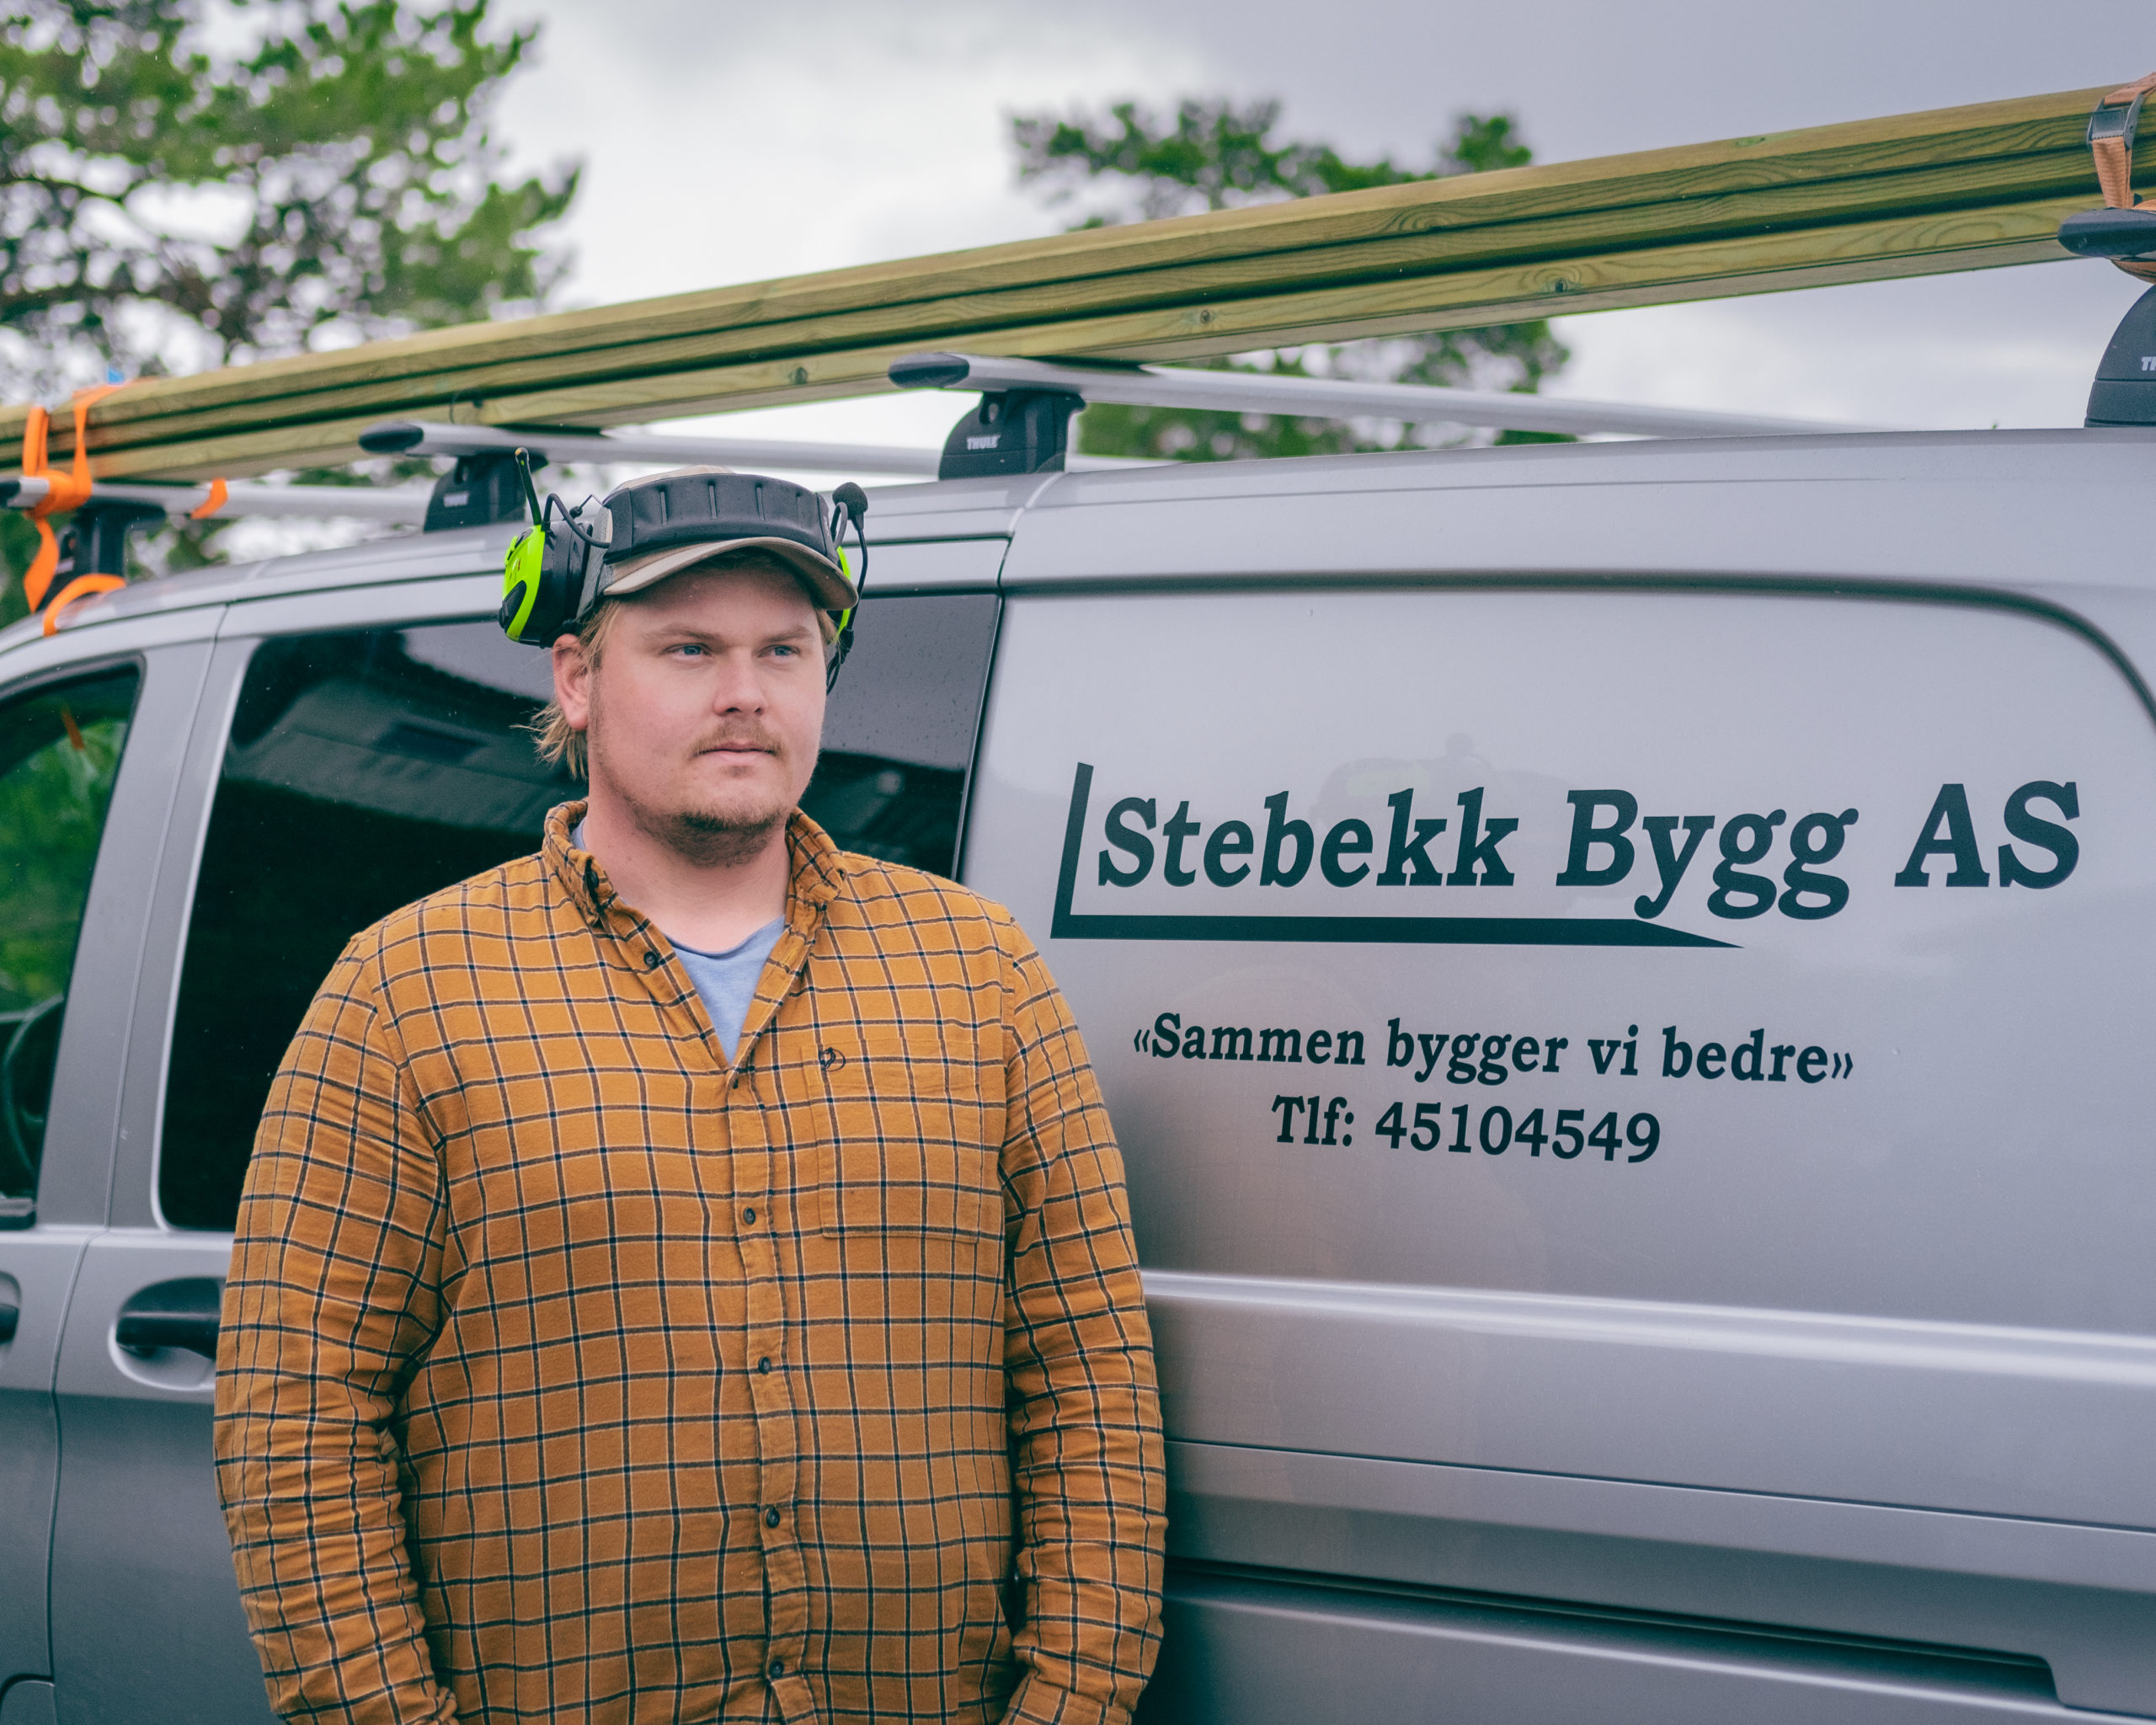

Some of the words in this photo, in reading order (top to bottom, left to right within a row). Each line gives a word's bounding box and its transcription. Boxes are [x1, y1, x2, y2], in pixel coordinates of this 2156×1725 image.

[966, 436, 999, 450] THULE
[1097, 787, 1519, 888] Stebekk
[1556, 789, 1860, 921] Bygg
[1894, 780, 2080, 889] AS
[1134, 1012, 1366, 1065] «Sammen
[1386, 1017, 1569, 1087] bygger
[1587, 1023, 1639, 1076] vi
[1662, 1025, 1854, 1084] bedre»
[1271, 1094, 1355, 1147] Tlf:
[1374, 1101, 1661, 1164] 45104549
